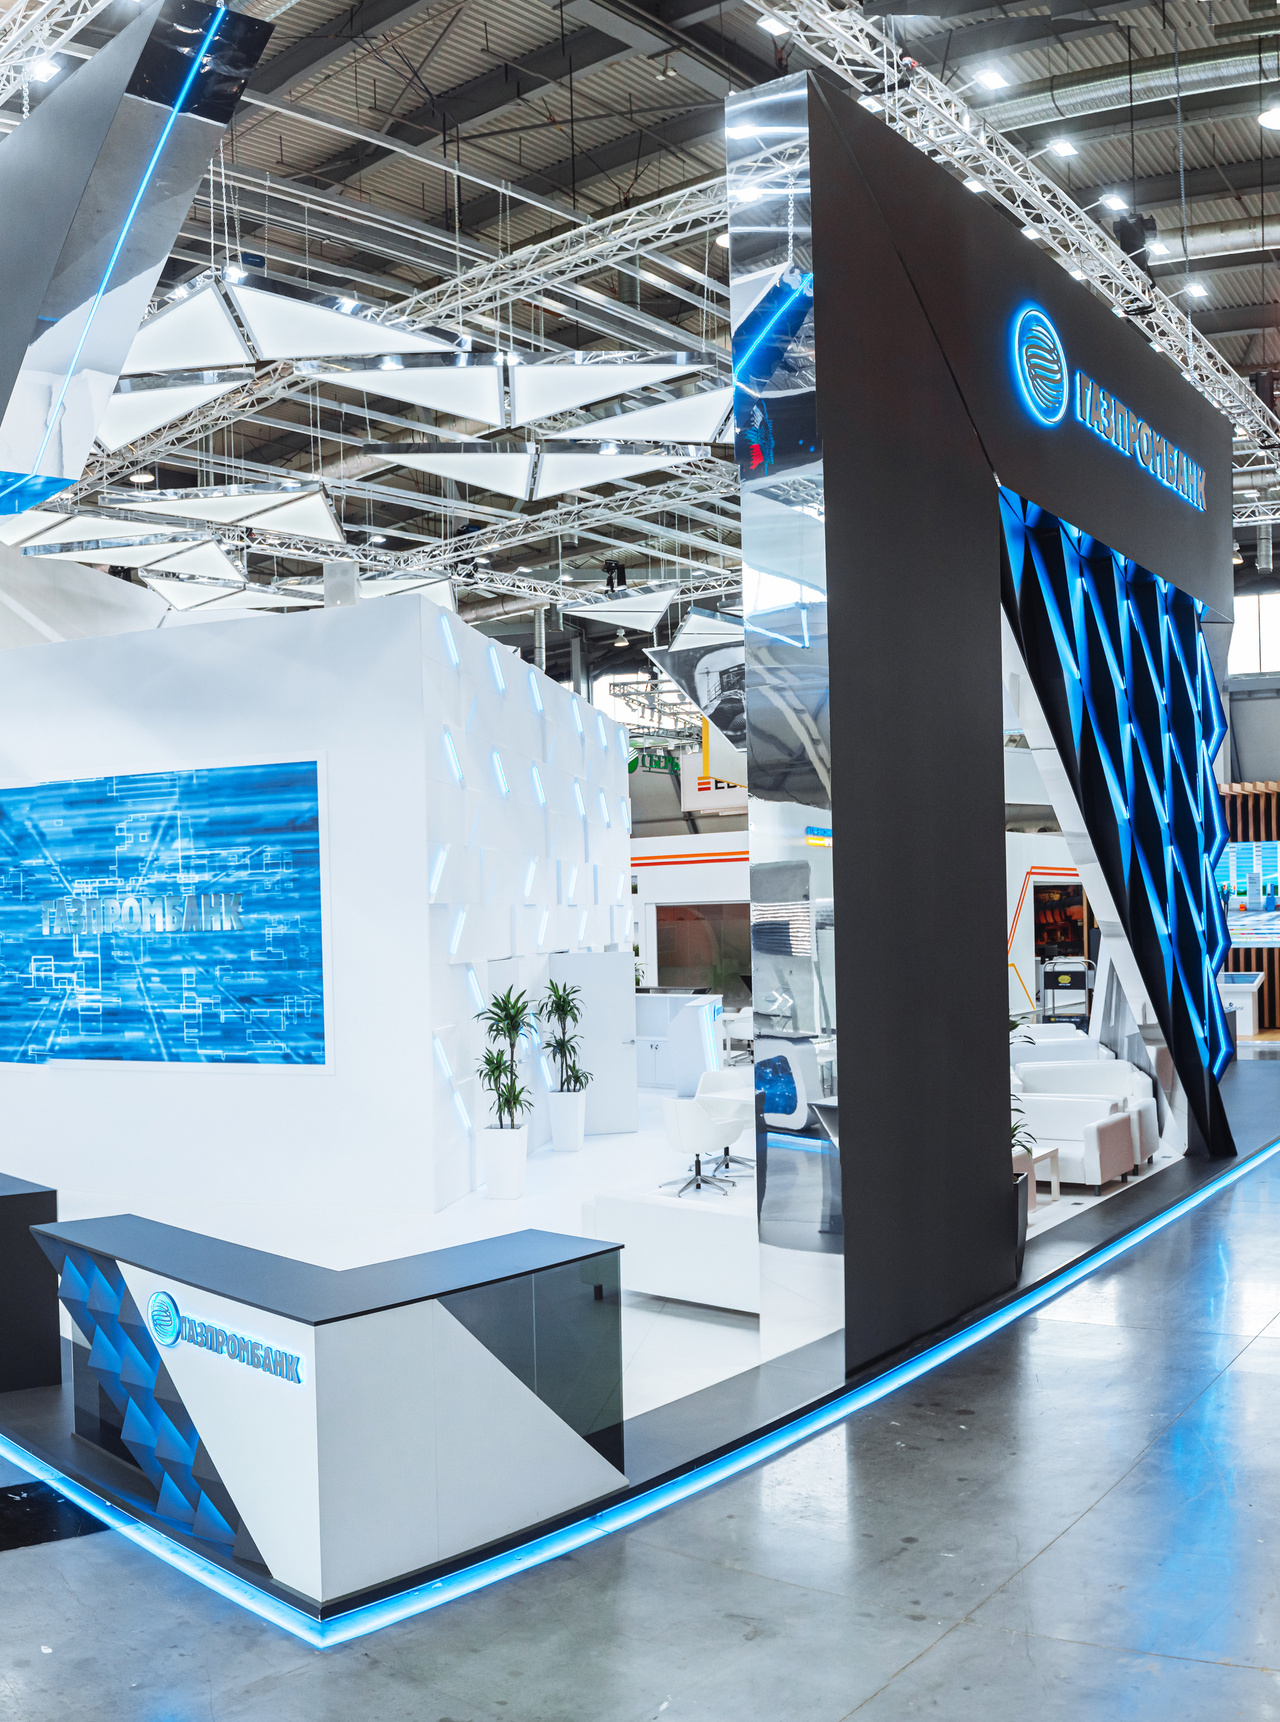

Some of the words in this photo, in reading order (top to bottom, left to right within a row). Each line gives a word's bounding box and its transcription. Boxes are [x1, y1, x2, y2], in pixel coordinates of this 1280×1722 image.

[1076, 370, 1208, 512] ГАЗПРОМБАНК
[41, 893, 245, 936] ГАЗПРОМБАНК
[180, 1315, 303, 1385] ГАЗПРОМБАНК
